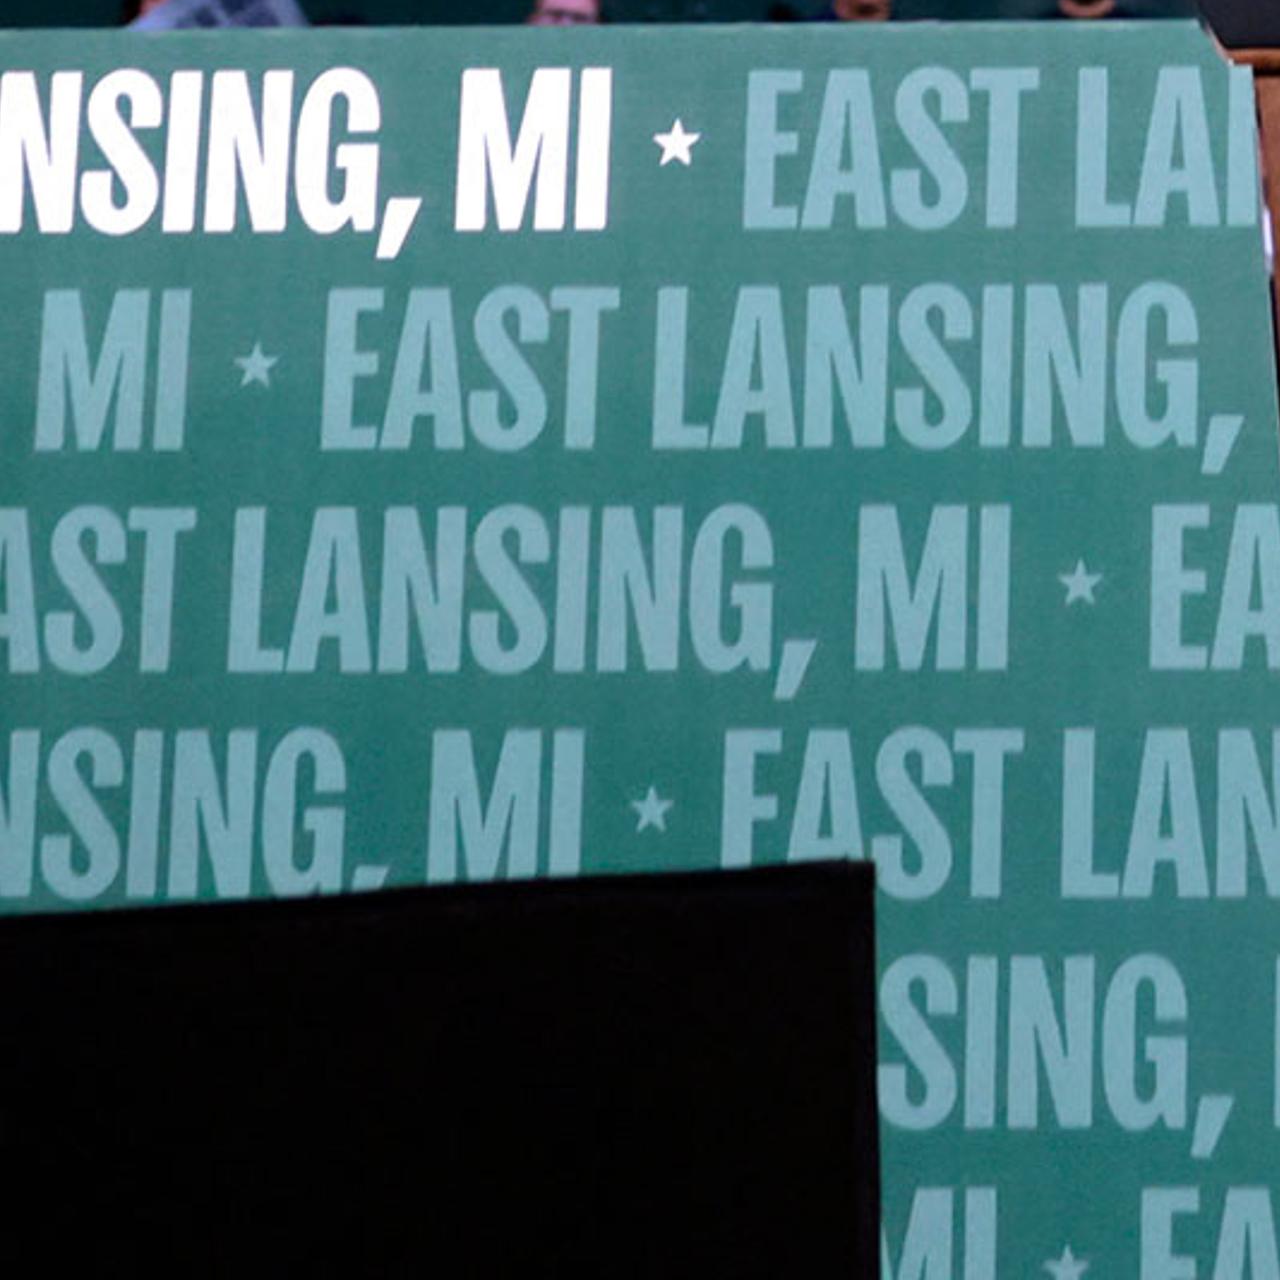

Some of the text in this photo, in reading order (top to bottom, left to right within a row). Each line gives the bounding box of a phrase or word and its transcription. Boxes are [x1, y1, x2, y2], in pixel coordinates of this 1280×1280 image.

[0, 64, 424, 262] NSING,
[453, 63, 614, 234] MI
[741, 63, 1043, 231] EAST
[34, 280, 1245, 475] MI EAST LANSING,
[227, 504, 817, 699] LANSING,
[855, 503, 1012, 671] MI
[427, 728, 586, 883] MI
[720, 726, 1025, 900] EAST
[877, 953, 1233, 1158] SING,
